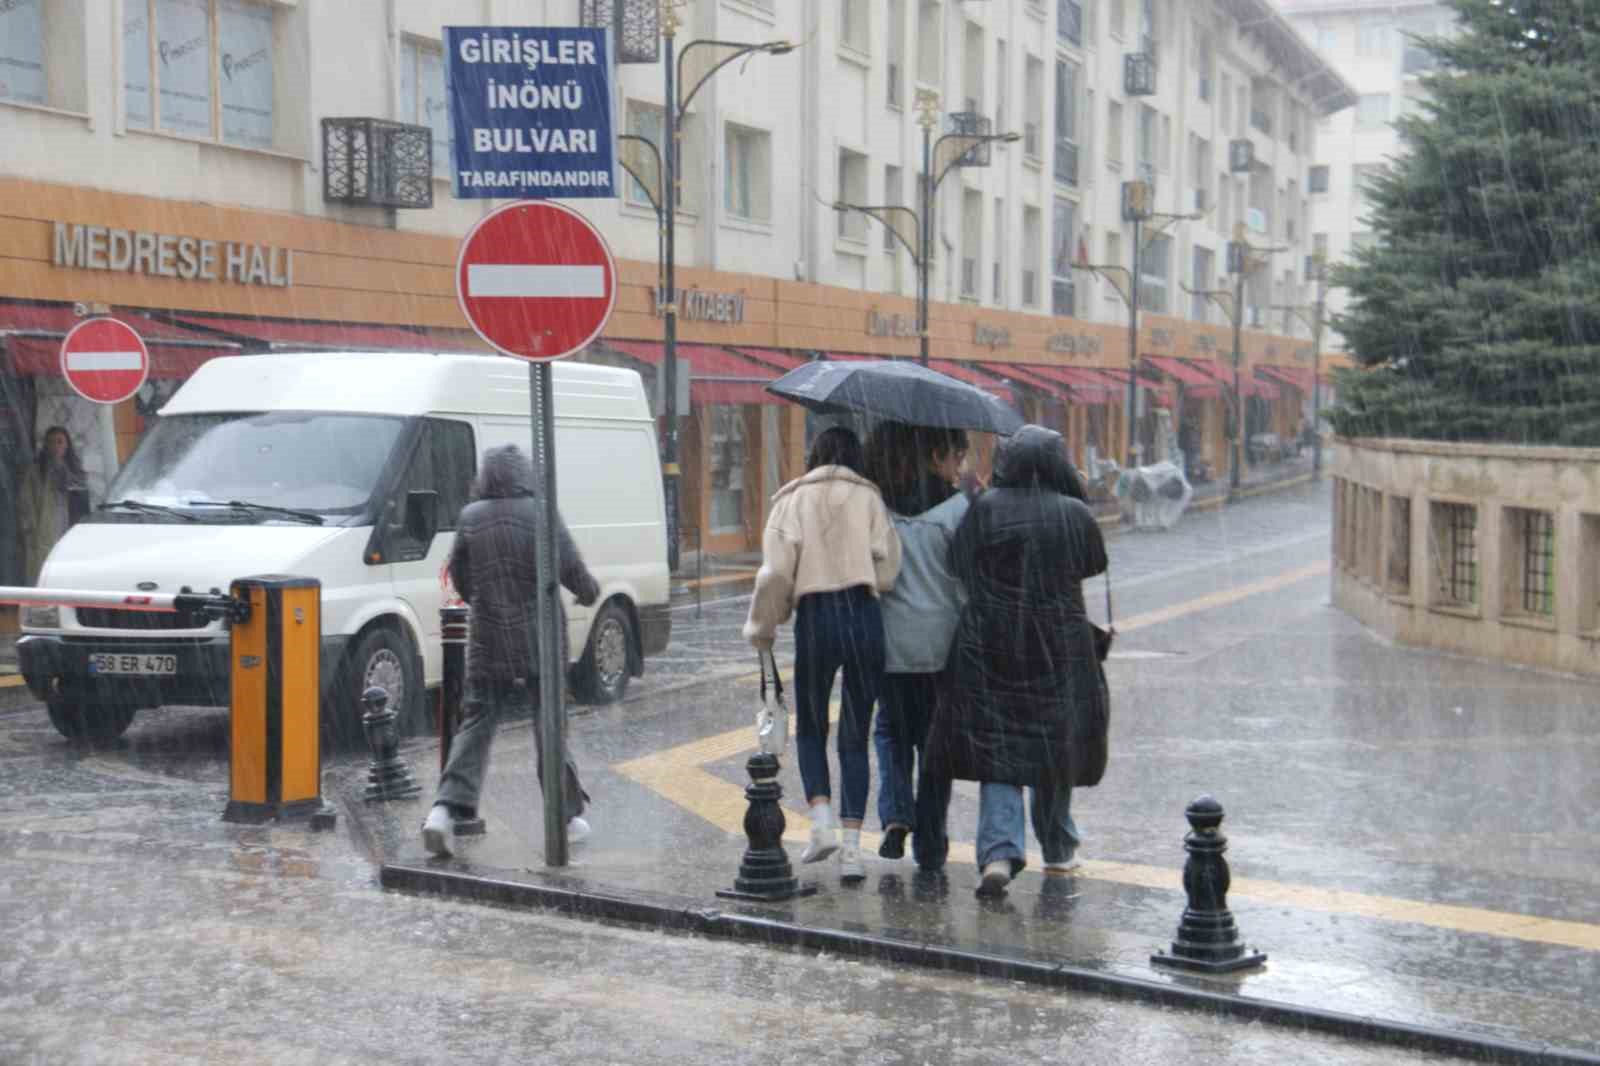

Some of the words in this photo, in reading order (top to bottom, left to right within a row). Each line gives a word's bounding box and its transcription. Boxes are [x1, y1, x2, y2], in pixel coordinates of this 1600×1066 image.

[459, 33, 597, 71] GİRİŞLER
[487, 78, 583, 110] İNÖNÜ
[473, 128, 597, 153] BULVARI
[460, 170, 610, 188] TARAFINDANDIR
[53, 221, 217, 281] MEDRESE
[226, 240, 294, 289] HALI
[96, 655, 115, 674] 58
[120, 656, 140, 674] ER
[145, 656, 175, 674] 470
